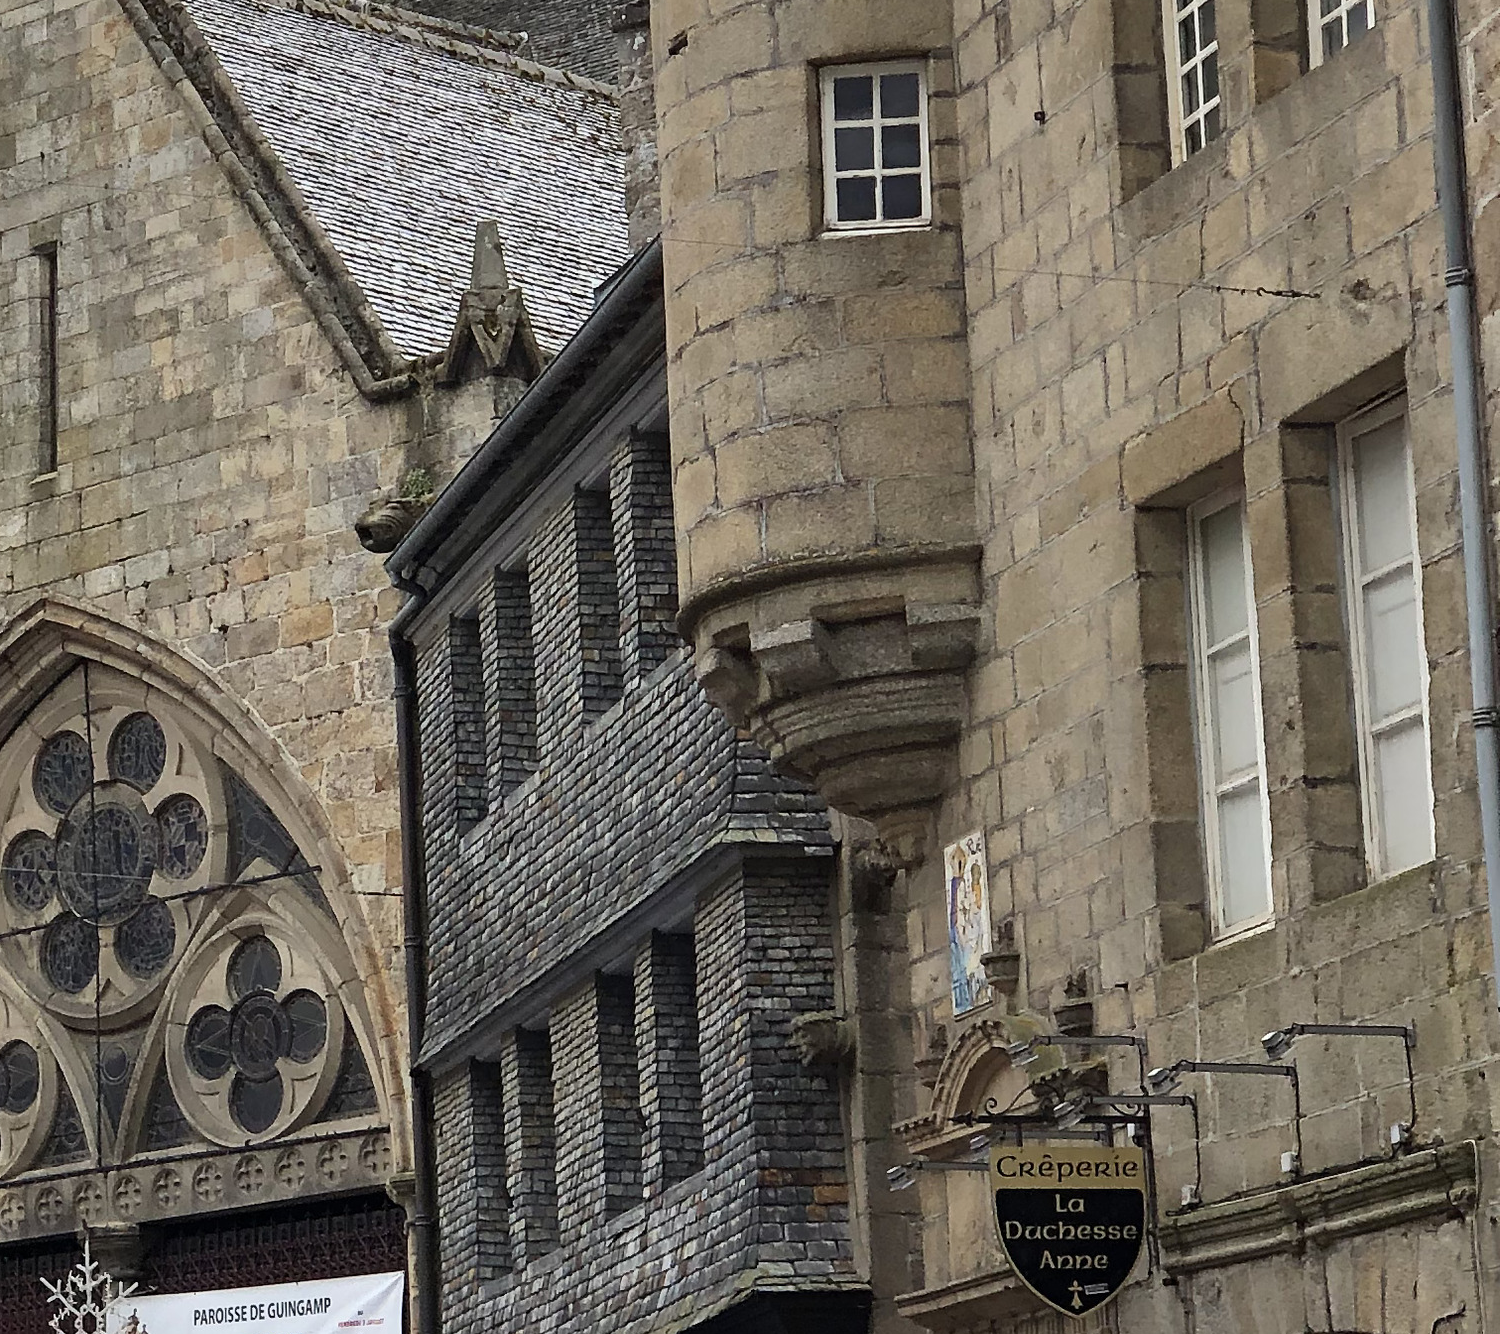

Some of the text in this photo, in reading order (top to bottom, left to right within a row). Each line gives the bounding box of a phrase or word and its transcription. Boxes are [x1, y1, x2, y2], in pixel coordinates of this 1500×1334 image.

[996, 1153, 1139, 1183] Crêperie
[1054, 1193, 1085, 1213] La
[1005, 1220, 1139, 1240] Duchesse
[1039, 1249, 1109, 1269] Anne
[193, 1297, 332, 1326] PAROISSE DE GUINGAMP
